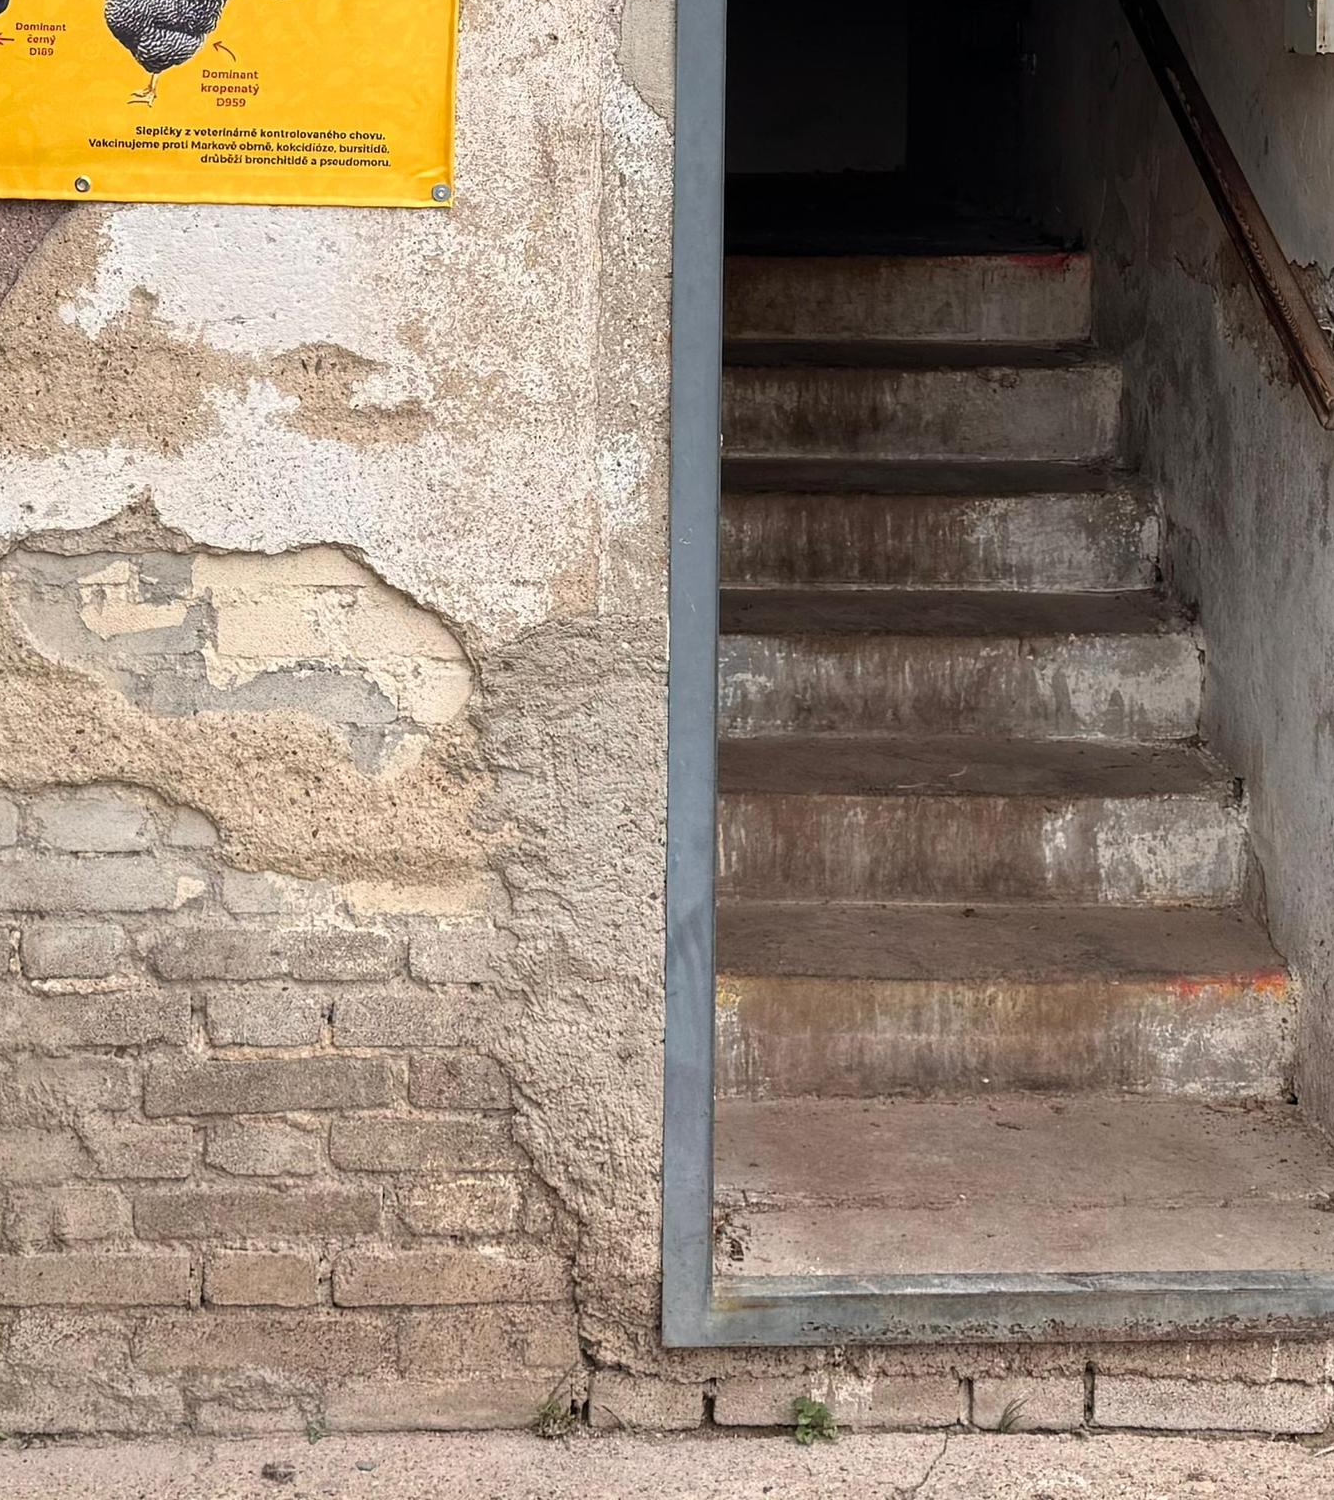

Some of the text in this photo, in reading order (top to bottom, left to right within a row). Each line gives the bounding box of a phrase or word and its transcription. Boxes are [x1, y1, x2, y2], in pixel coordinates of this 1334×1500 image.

[14, 22, 67, 32] Dominant
[27, 33, 56, 46] černý
[202, 69, 259, 80] Dominant
[200, 83, 260, 96] kropenatý
[216, 97, 247, 107] D959
[135, 125, 182, 137] Slepičky
[194, 128, 257, 138] veterinárně
[260, 128, 347, 140] kontrolovaného
[349, 130, 386, 140] chovu.
[88, 138, 160, 151] Vakcinujeme
[162, 139, 188, 151] proti
[276, 142, 337, 153] kokcidióze,
[339, 143, 390, 154] bursitidě,
[200, 153, 391, 168] drůběží bronchitidě a pseudomoru.
